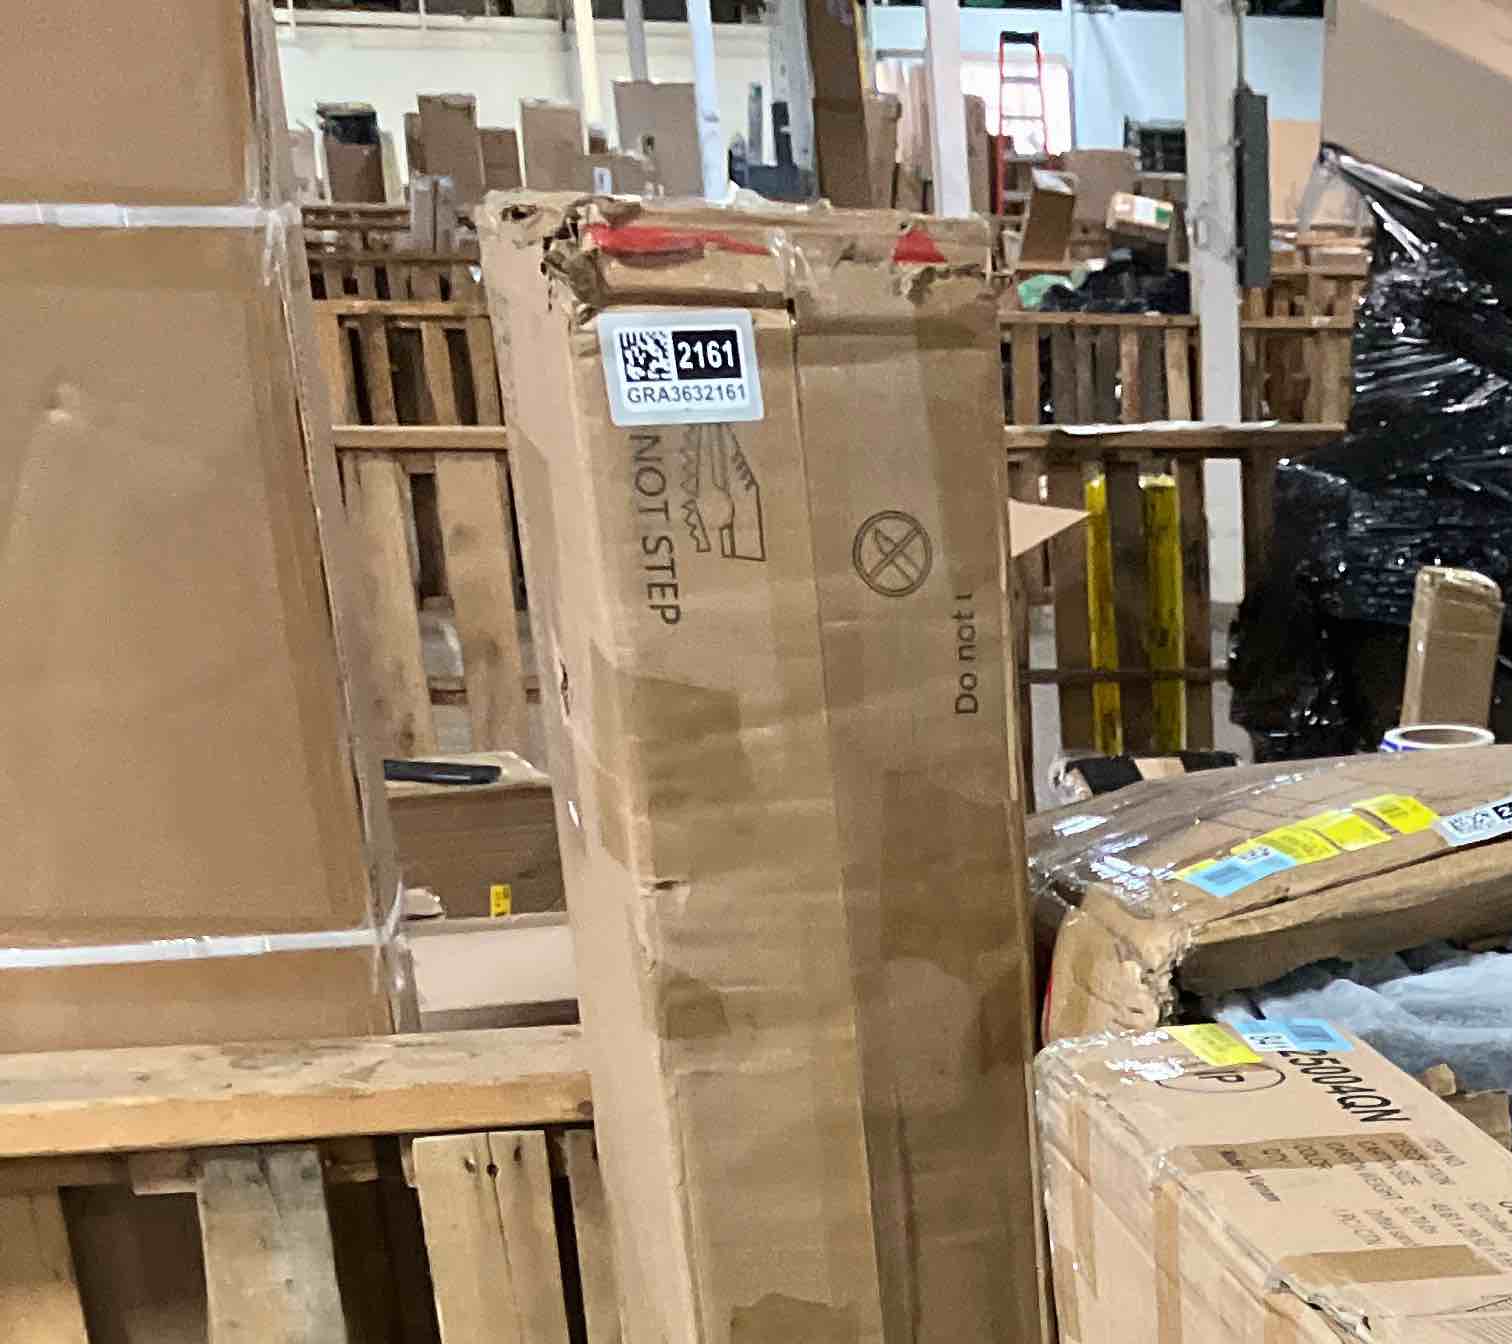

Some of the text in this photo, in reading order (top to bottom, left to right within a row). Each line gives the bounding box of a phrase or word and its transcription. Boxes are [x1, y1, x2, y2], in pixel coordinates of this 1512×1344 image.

[676, 338, 737, 371] 2161
[627, 384, 747, 404] GRA3632161
[629, 434, 682, 626] NOT STEP
[953, 609, 977, 662] not
[955, 673, 979, 715] Do
